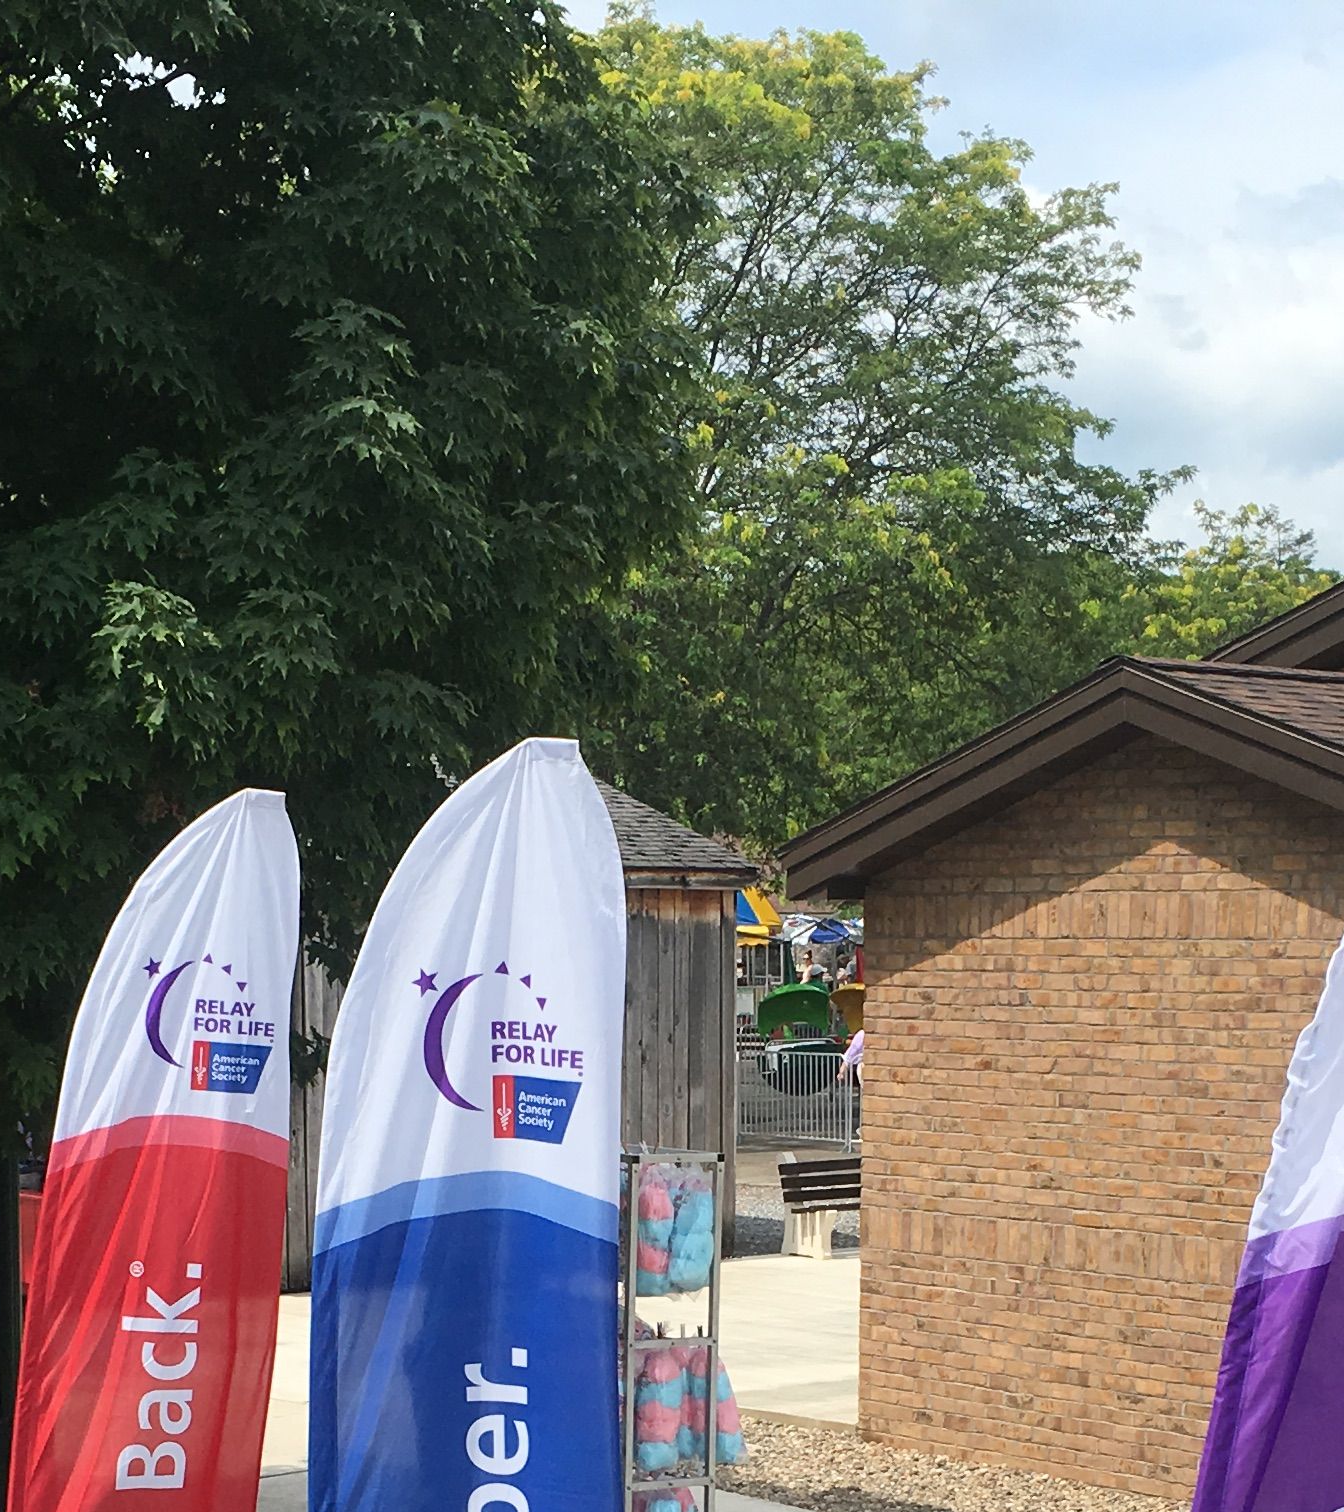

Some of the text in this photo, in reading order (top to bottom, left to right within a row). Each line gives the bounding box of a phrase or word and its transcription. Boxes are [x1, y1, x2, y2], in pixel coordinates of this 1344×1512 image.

[195, 998, 256, 1017] RELAY
[193, 1016, 275, 1037] FOR LIFE
[491, 1020, 558, 1043] RELAY
[212, 1053, 260, 1066] American
[491, 1044, 584, 1069] FOR LIFE
[211, 1063, 246, 1073] Cancer
[211, 1072, 248, 1085] Society
[518, 1090, 568, 1108] American
[518, 1102, 553, 1117] Cancer
[518, 1113, 555, 1132] Society
[115, 1262, 203, 1491] Back.
